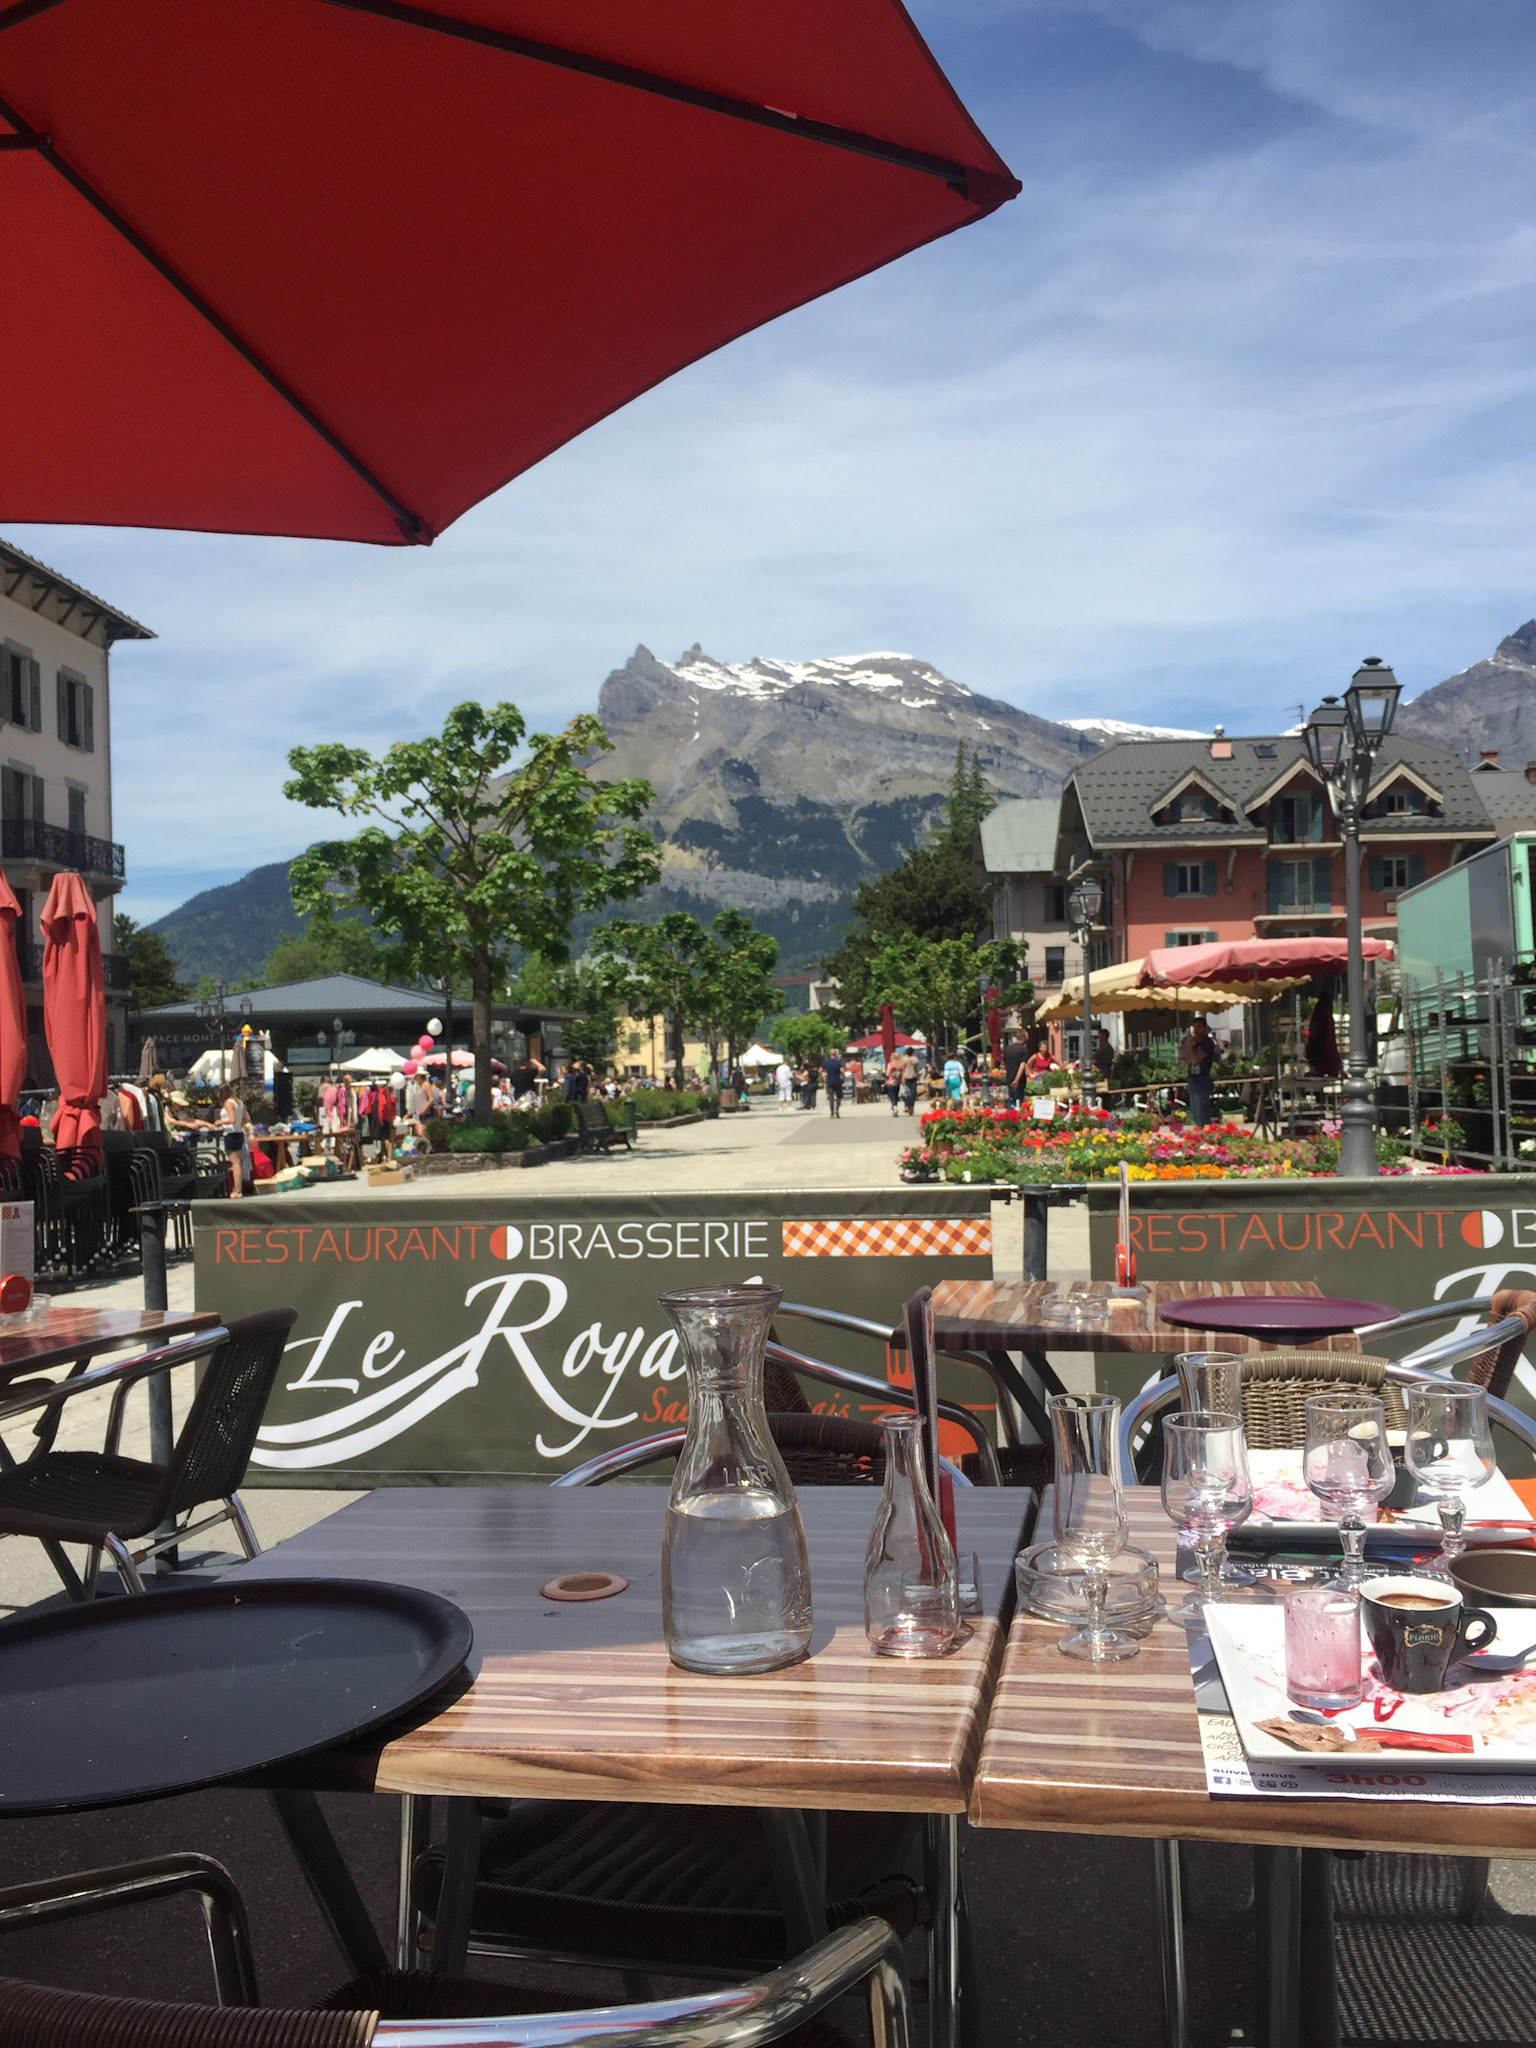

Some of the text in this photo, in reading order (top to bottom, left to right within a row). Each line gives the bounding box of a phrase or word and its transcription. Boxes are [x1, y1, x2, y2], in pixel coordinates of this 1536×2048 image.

[141, 1034, 179, 1044] EPACE
[183, 1034, 215, 1044] MONT
[216, 1221, 769, 1264] RESTAURANT BRASSERIE
[1117, 1210, 1455, 1252] RESTAURANT
[286, 1300, 405, 1394] Le
[1213, 1768, 1297, 1779] SUIVEZ-NOUS
[1325, 1773, 1427, 1787] 3h00
